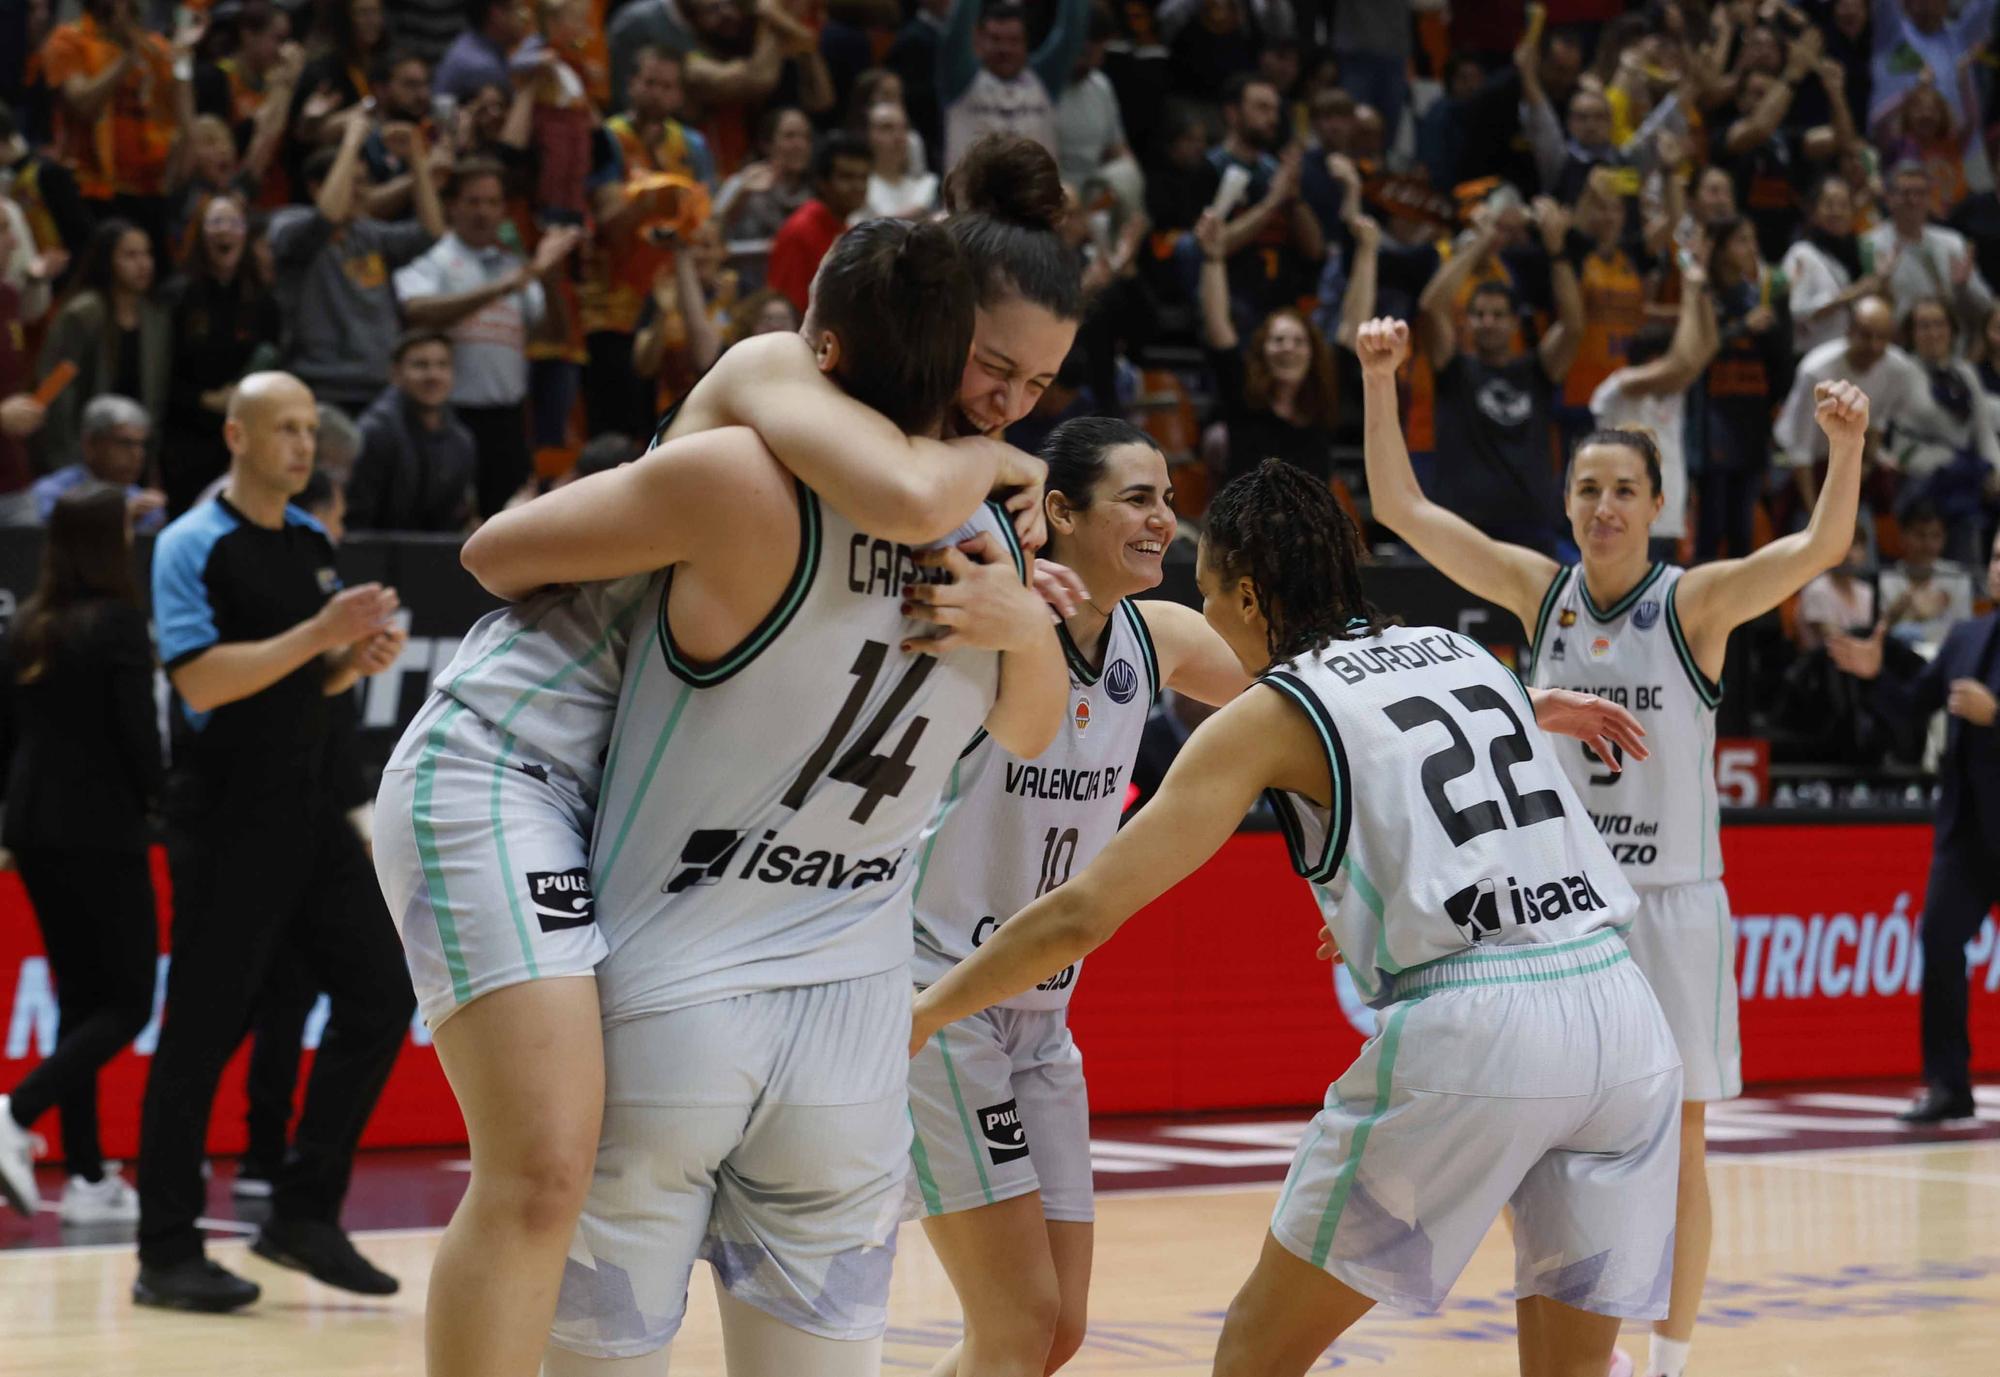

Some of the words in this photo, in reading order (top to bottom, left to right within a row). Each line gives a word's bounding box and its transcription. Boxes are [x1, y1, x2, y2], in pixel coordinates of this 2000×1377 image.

[1324, 633, 1475, 685] BURDICK
[1636, 686, 1662, 710] BC
[780, 639, 938, 825] 14
[1005, 762, 1101, 801] VALENCIA
[1382, 684, 1566, 848] 22
[1634, 822, 1658, 836] del
[739, 829, 907, 889] isaval
[1035, 827, 1079, 899] 10
